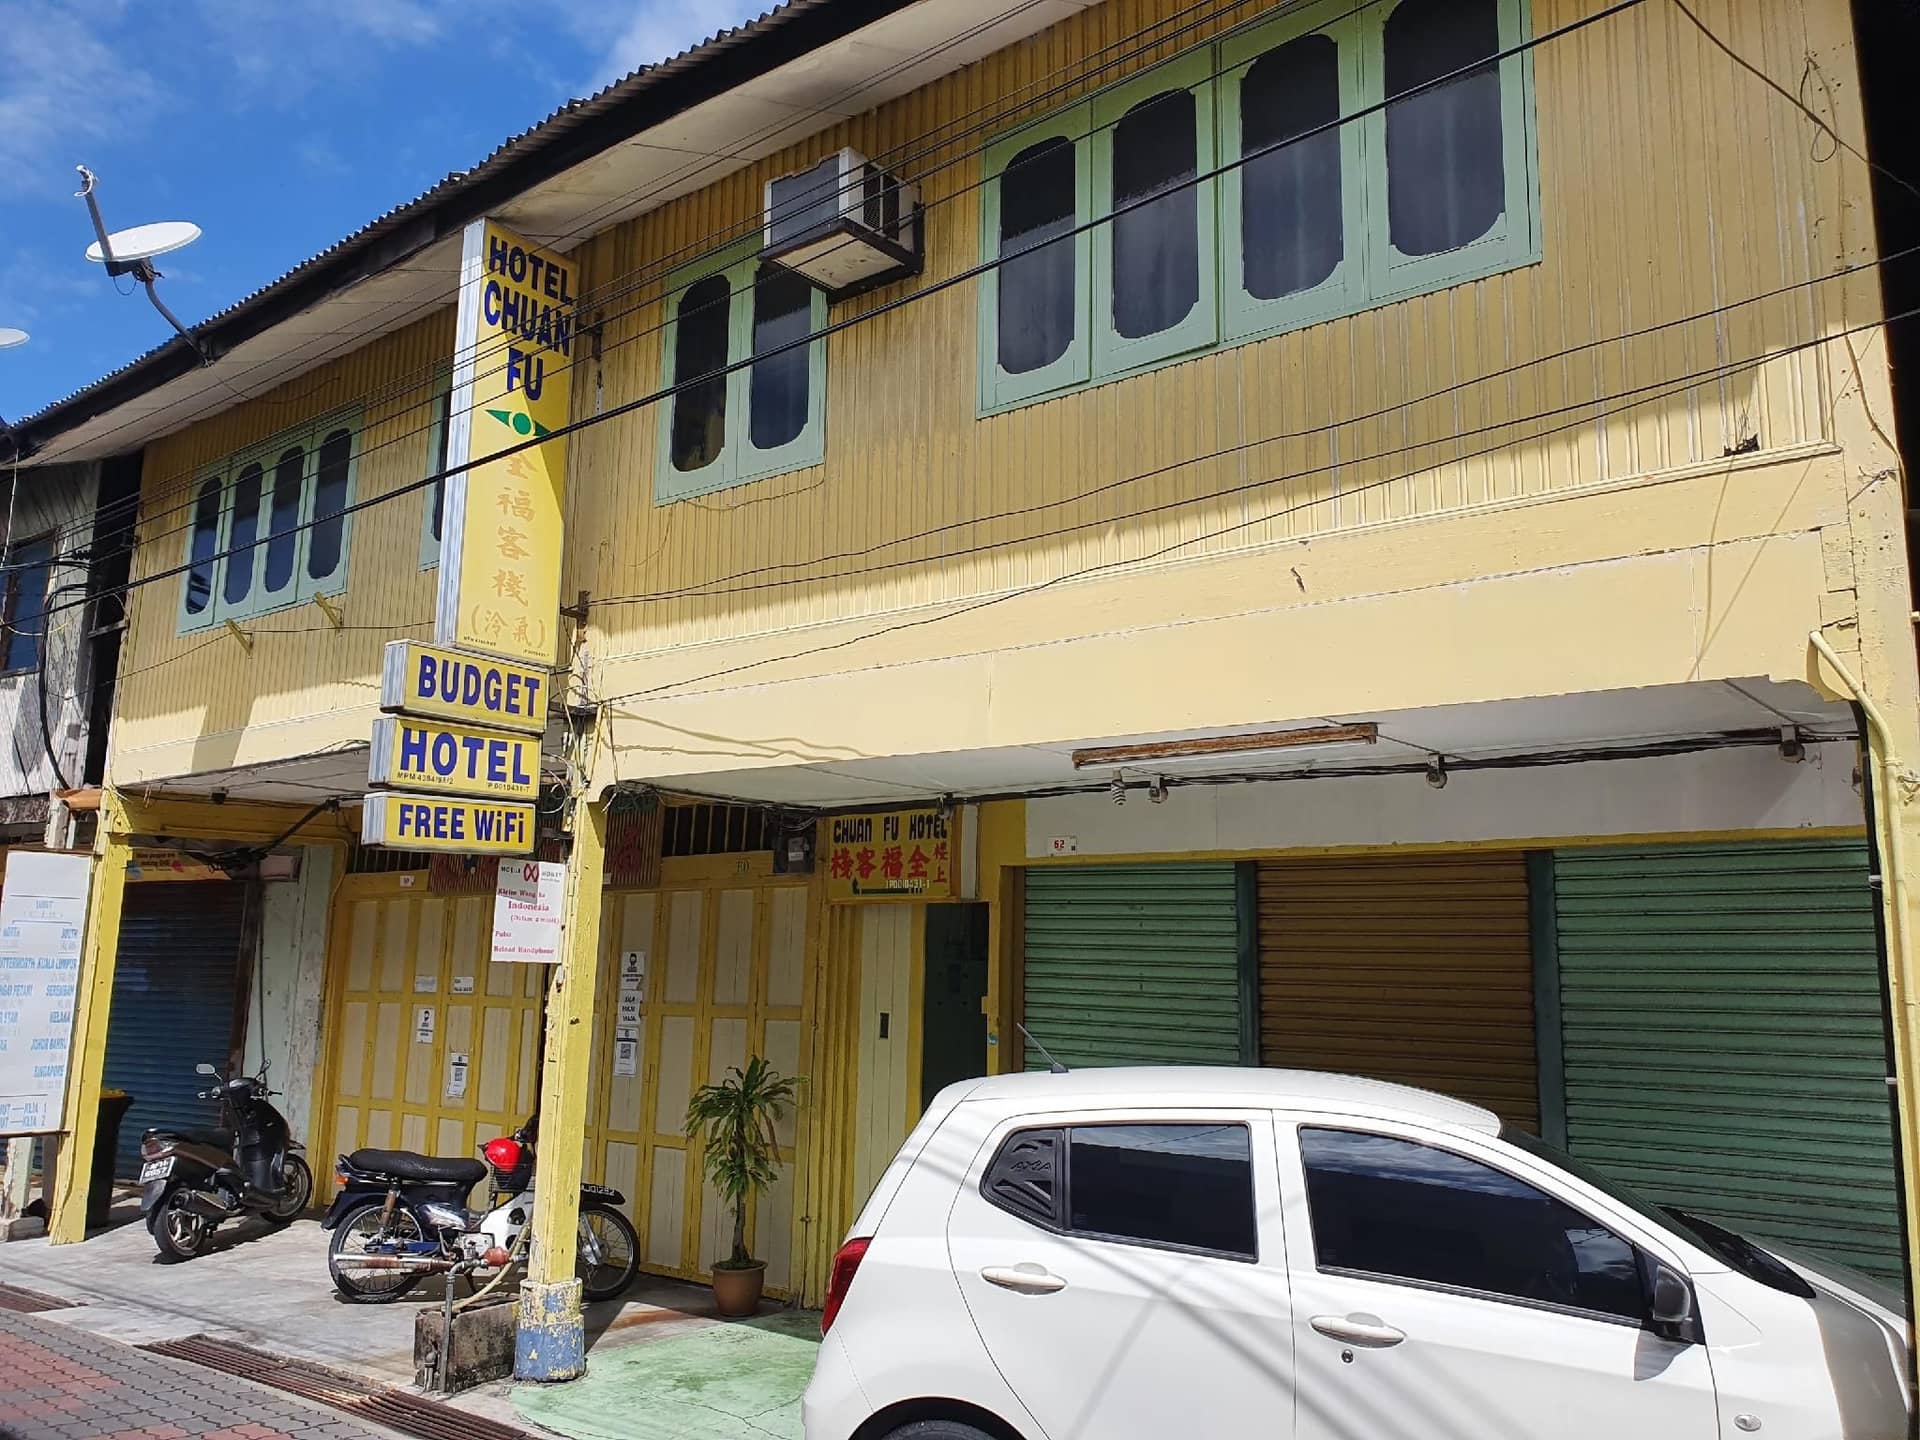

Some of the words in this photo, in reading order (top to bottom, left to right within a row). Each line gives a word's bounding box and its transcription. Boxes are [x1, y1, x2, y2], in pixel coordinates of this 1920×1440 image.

[488, 235, 573, 304] HOTEL
[484, 279, 571, 357] CHUAN
[506, 346, 544, 400] FU
[418, 655, 541, 718] BUDGET
[400, 728, 531, 785] HOTEL
[398, 804, 465, 840] FREE
[474, 808, 525, 844] WiFi
[833, 818, 873, 843] CHUAN
[882, 816, 899, 841] FU
[908, 814, 948, 841] HOTEL
[1054, 839, 1065, 849] 62
[508, 900, 550, 911] Indonesia
